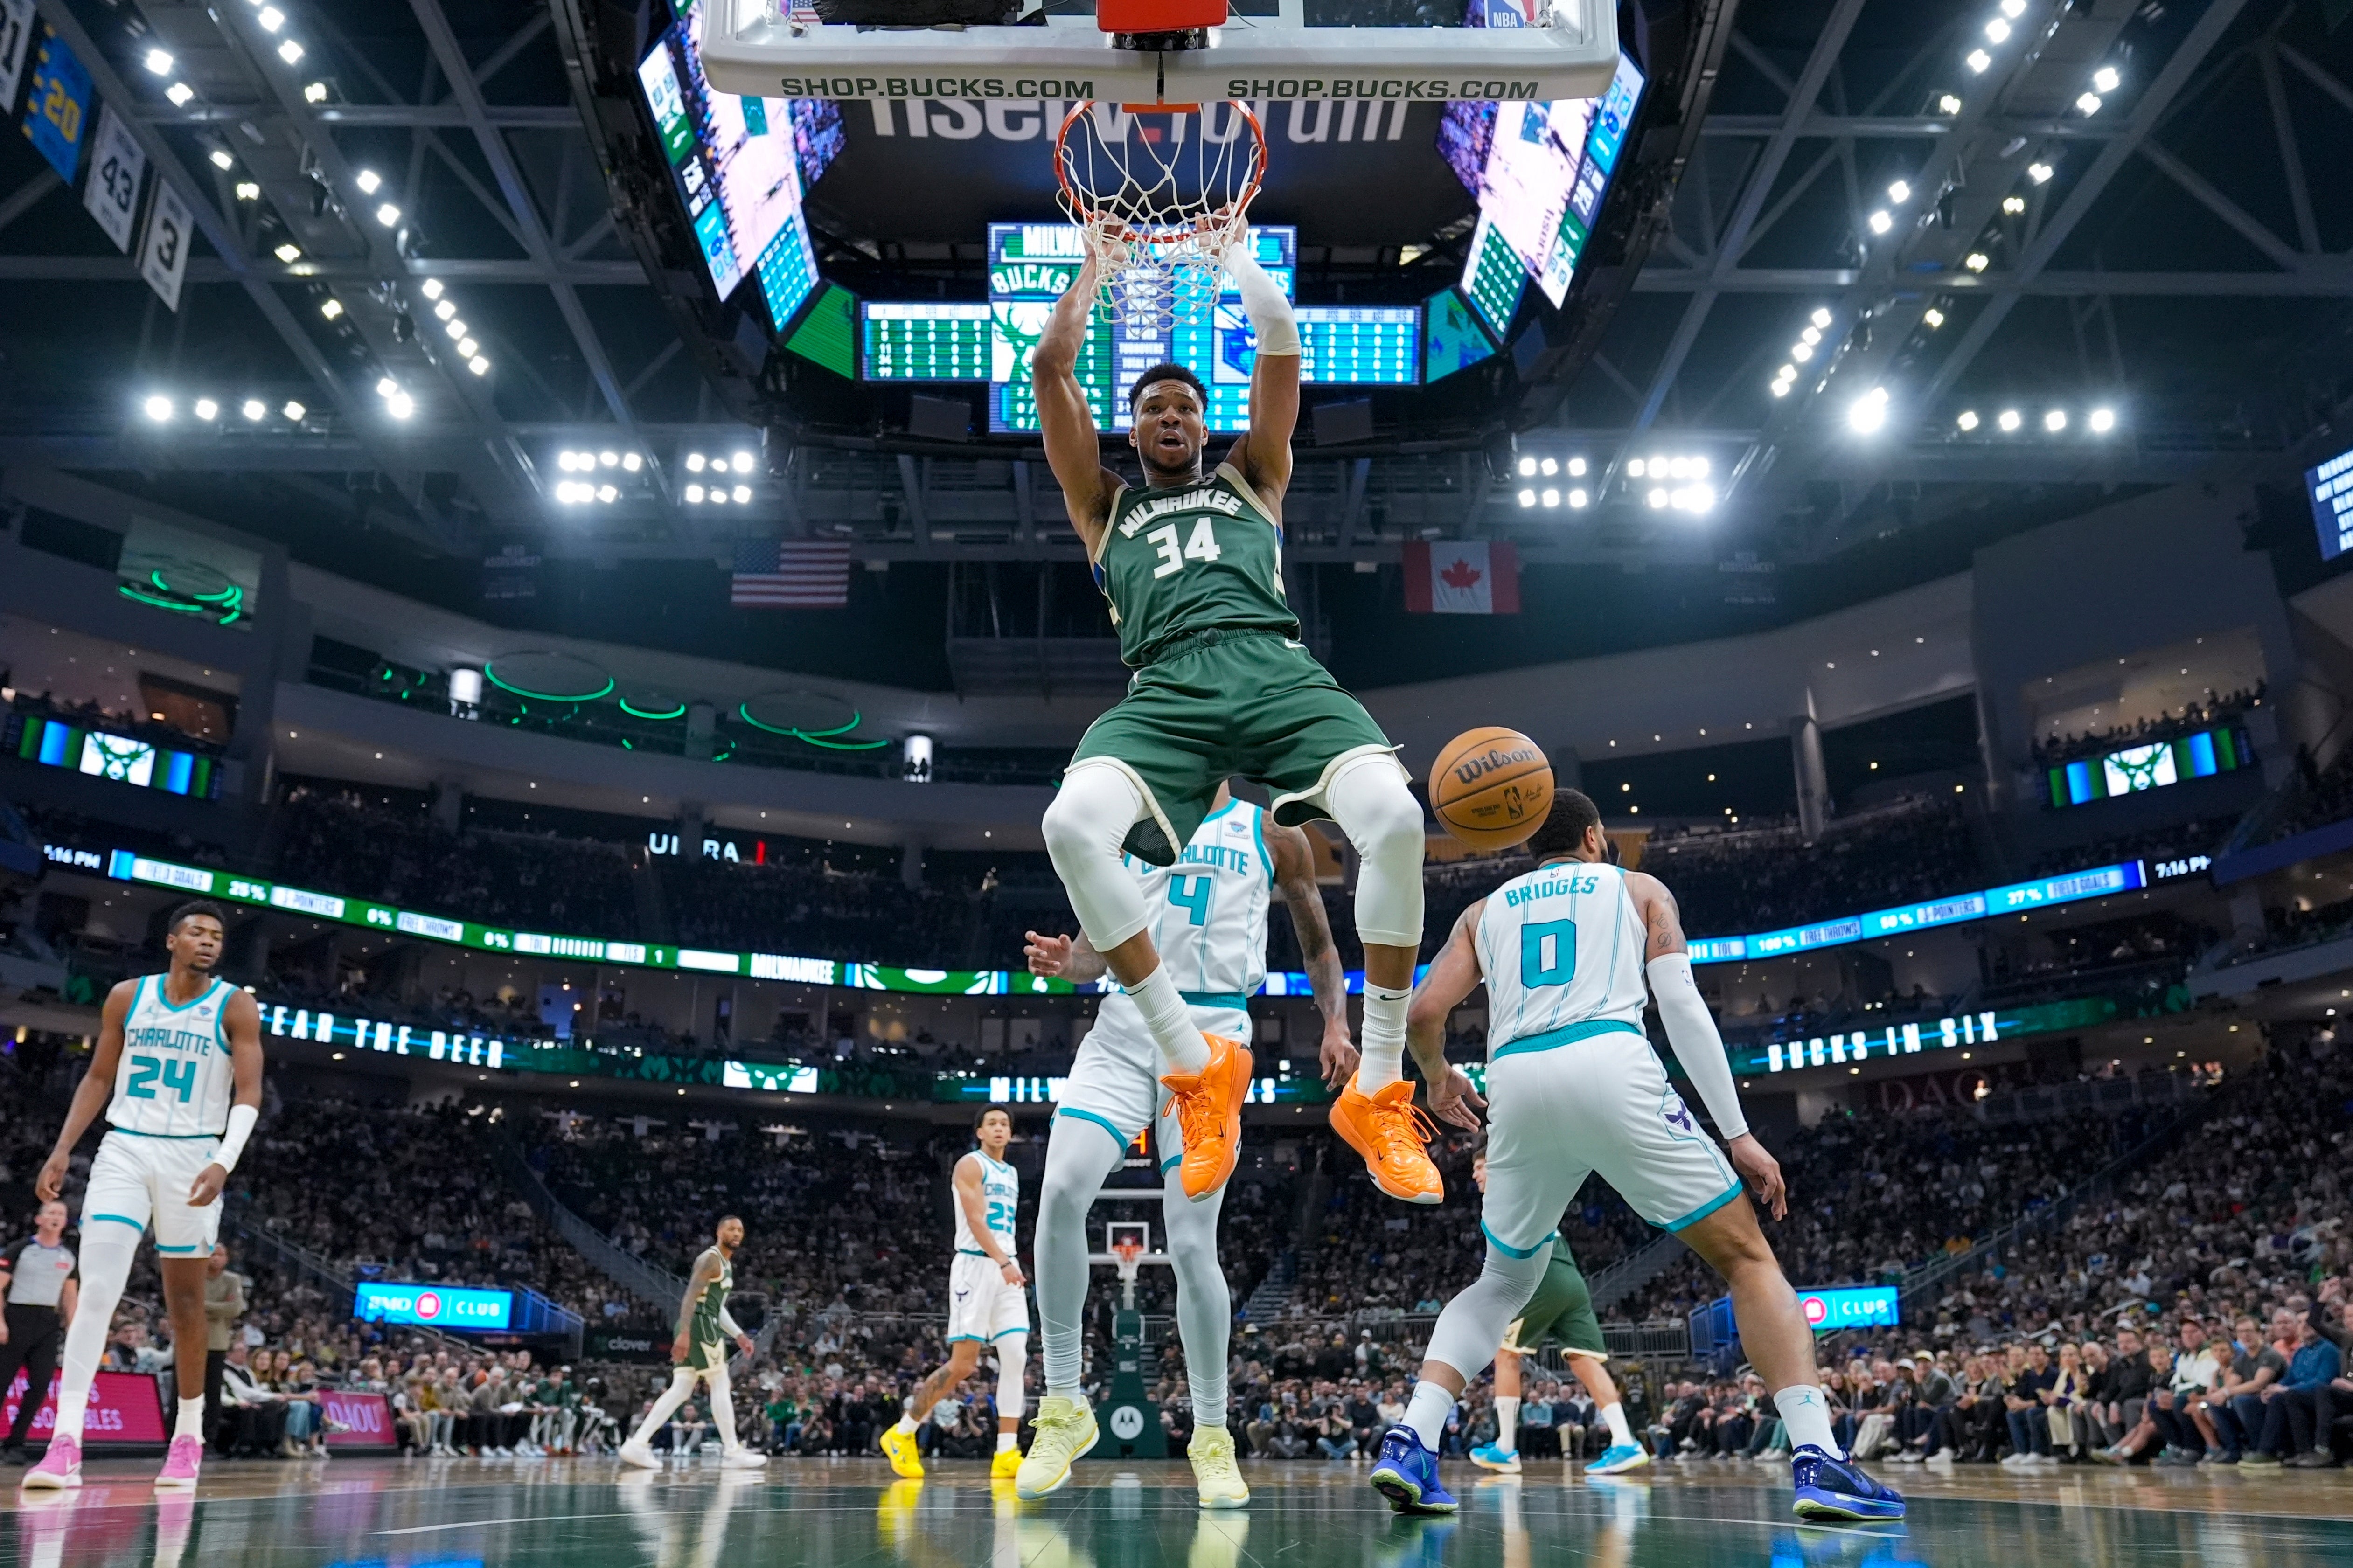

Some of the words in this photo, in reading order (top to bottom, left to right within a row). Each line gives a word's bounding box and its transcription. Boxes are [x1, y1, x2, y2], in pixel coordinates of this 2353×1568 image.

[1493, 12, 1518, 27] NBA
[781, 78, 1093, 98] SHOP.BUCKS.COM
[1228, 80, 1538, 99] SHOP.BUCKS.COM
[44, 78, 81, 142] 20
[101, 156, 132, 214] 43
[157, 218, 178, 271] 3
[991, 264, 1070, 293] BUCKS
[1118, 489, 1242, 539] MILWAUKEE
[1147, 517, 1221, 579] 34
[1455, 749, 1537, 784] Wilson
[73, 851, 101, 869] PM
[1168, 874, 1211, 926] 4
[1505, 876, 1599, 908] BRIDGES
[654, 949, 663, 964] 1
[1521, 918, 1576, 990] 0
[1758, 935, 1796, 952] 100%
[750, 953, 835, 985] MILWAUKEE
[127, 1028, 212, 1057] CHARLOTTE
[355, 1018, 412, 1055] THE
[429, 1031, 504, 1069] DEER
[1767, 1030, 1868, 1073] BUCKS
[1886, 1021, 1922, 1055] IN
[1940, 1011, 1999, 1048] SIX
[127, 1055, 197, 1103] 24
[455, 1300, 501, 1317] CLUB
[1841, 1299, 1888, 1316] CLUB
[608, 1336, 652, 1351] clover
[328, 1401, 382, 1433] DAOU
